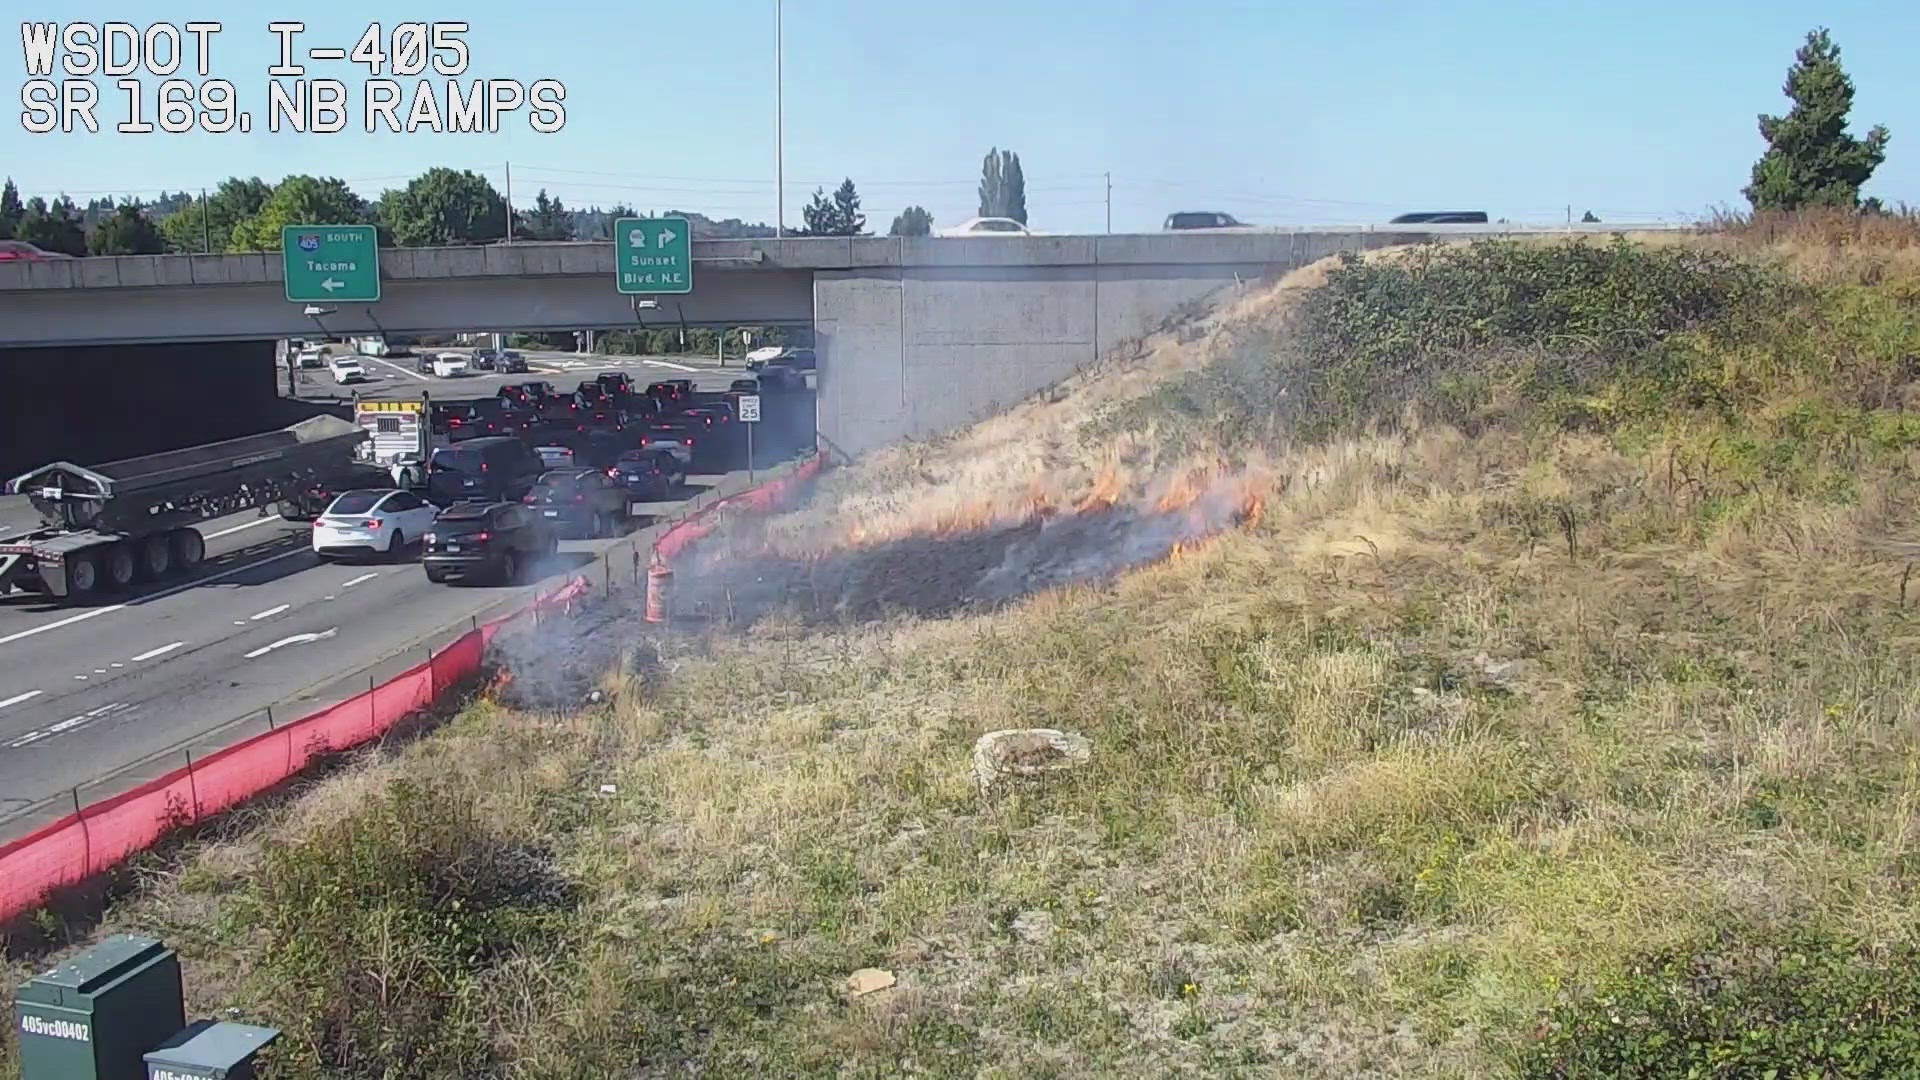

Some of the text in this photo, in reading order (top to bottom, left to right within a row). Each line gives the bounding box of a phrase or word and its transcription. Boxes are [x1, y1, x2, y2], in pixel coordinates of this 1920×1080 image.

[326, 233, 363, 242] SOUTH
[307, 261, 356, 271] Tacoma
[631, 255, 676, 266] Sunset
[741, 408, 758, 419] 25
[22, 1014, 89, 1042] 405vc00402
